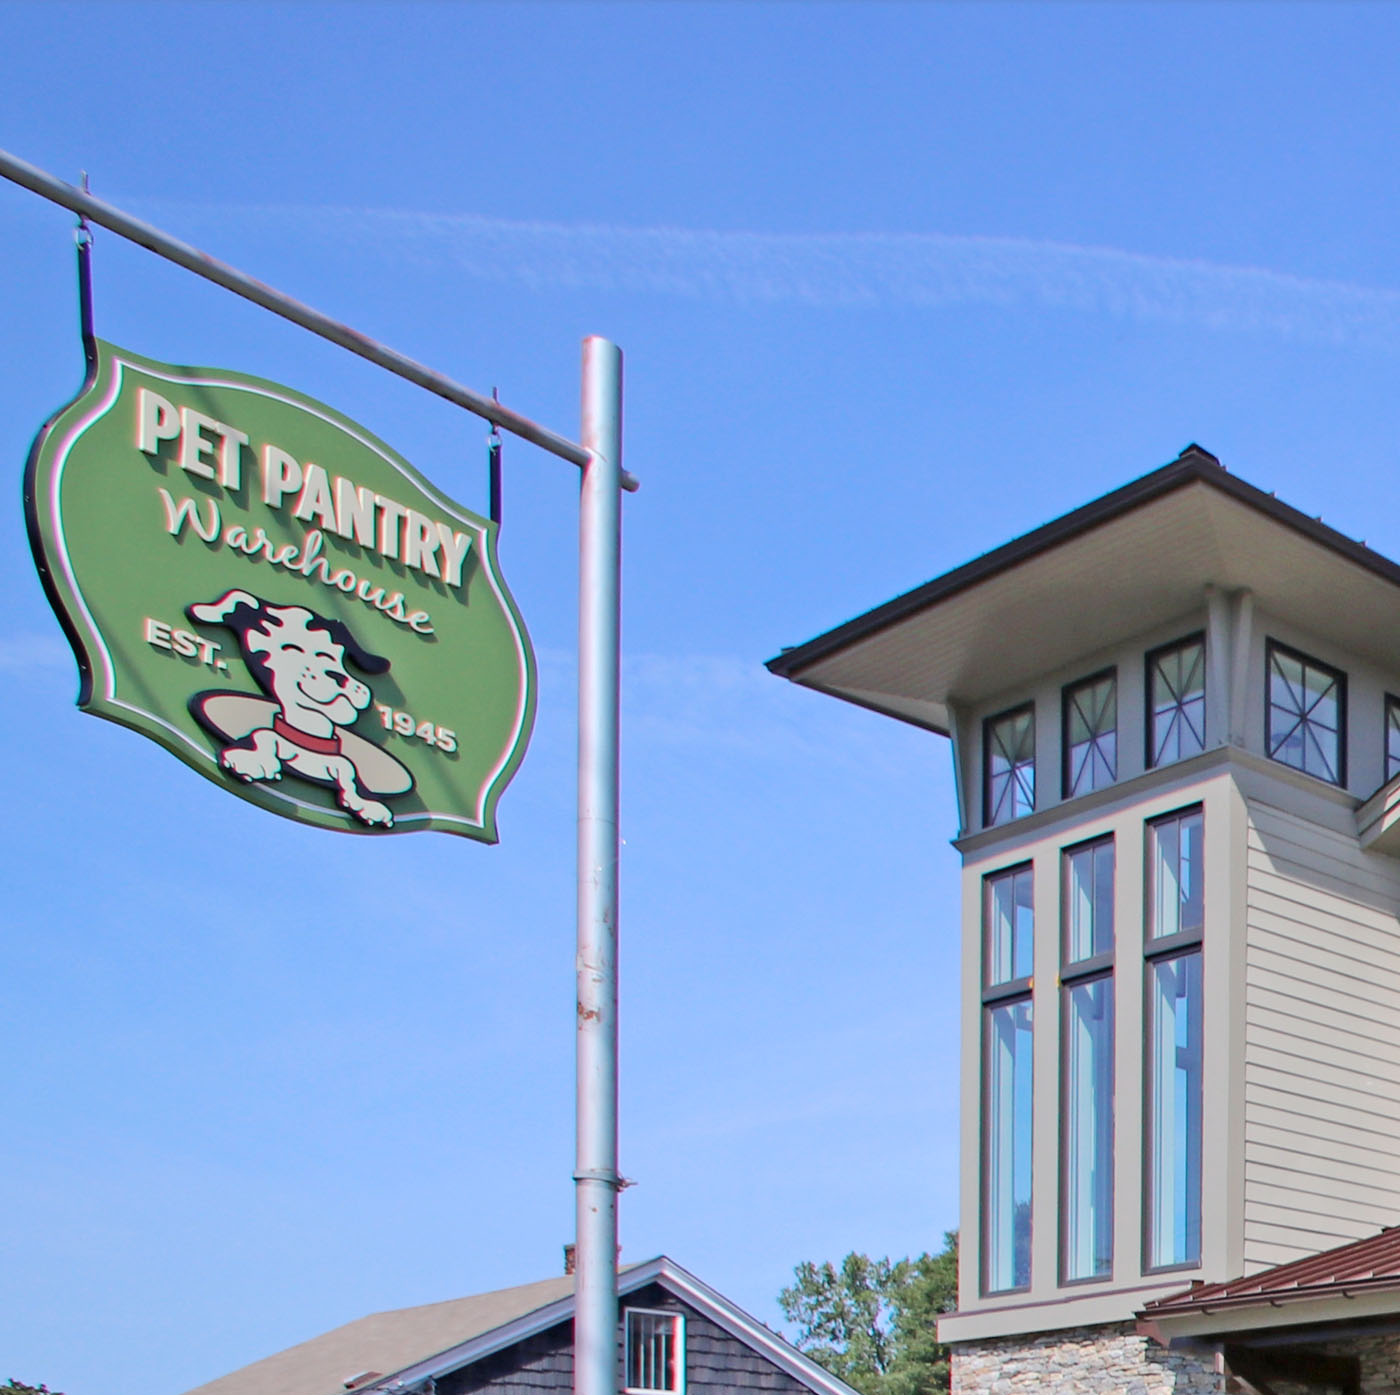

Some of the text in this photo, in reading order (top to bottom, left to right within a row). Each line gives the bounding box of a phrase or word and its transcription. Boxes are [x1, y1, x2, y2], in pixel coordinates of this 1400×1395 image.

[136, 387, 473, 588] PET PANTRY
[159, 487, 434, 635] Warehouse
[145, 618, 228, 670] EST.
[377, 704, 459, 753] 1945
